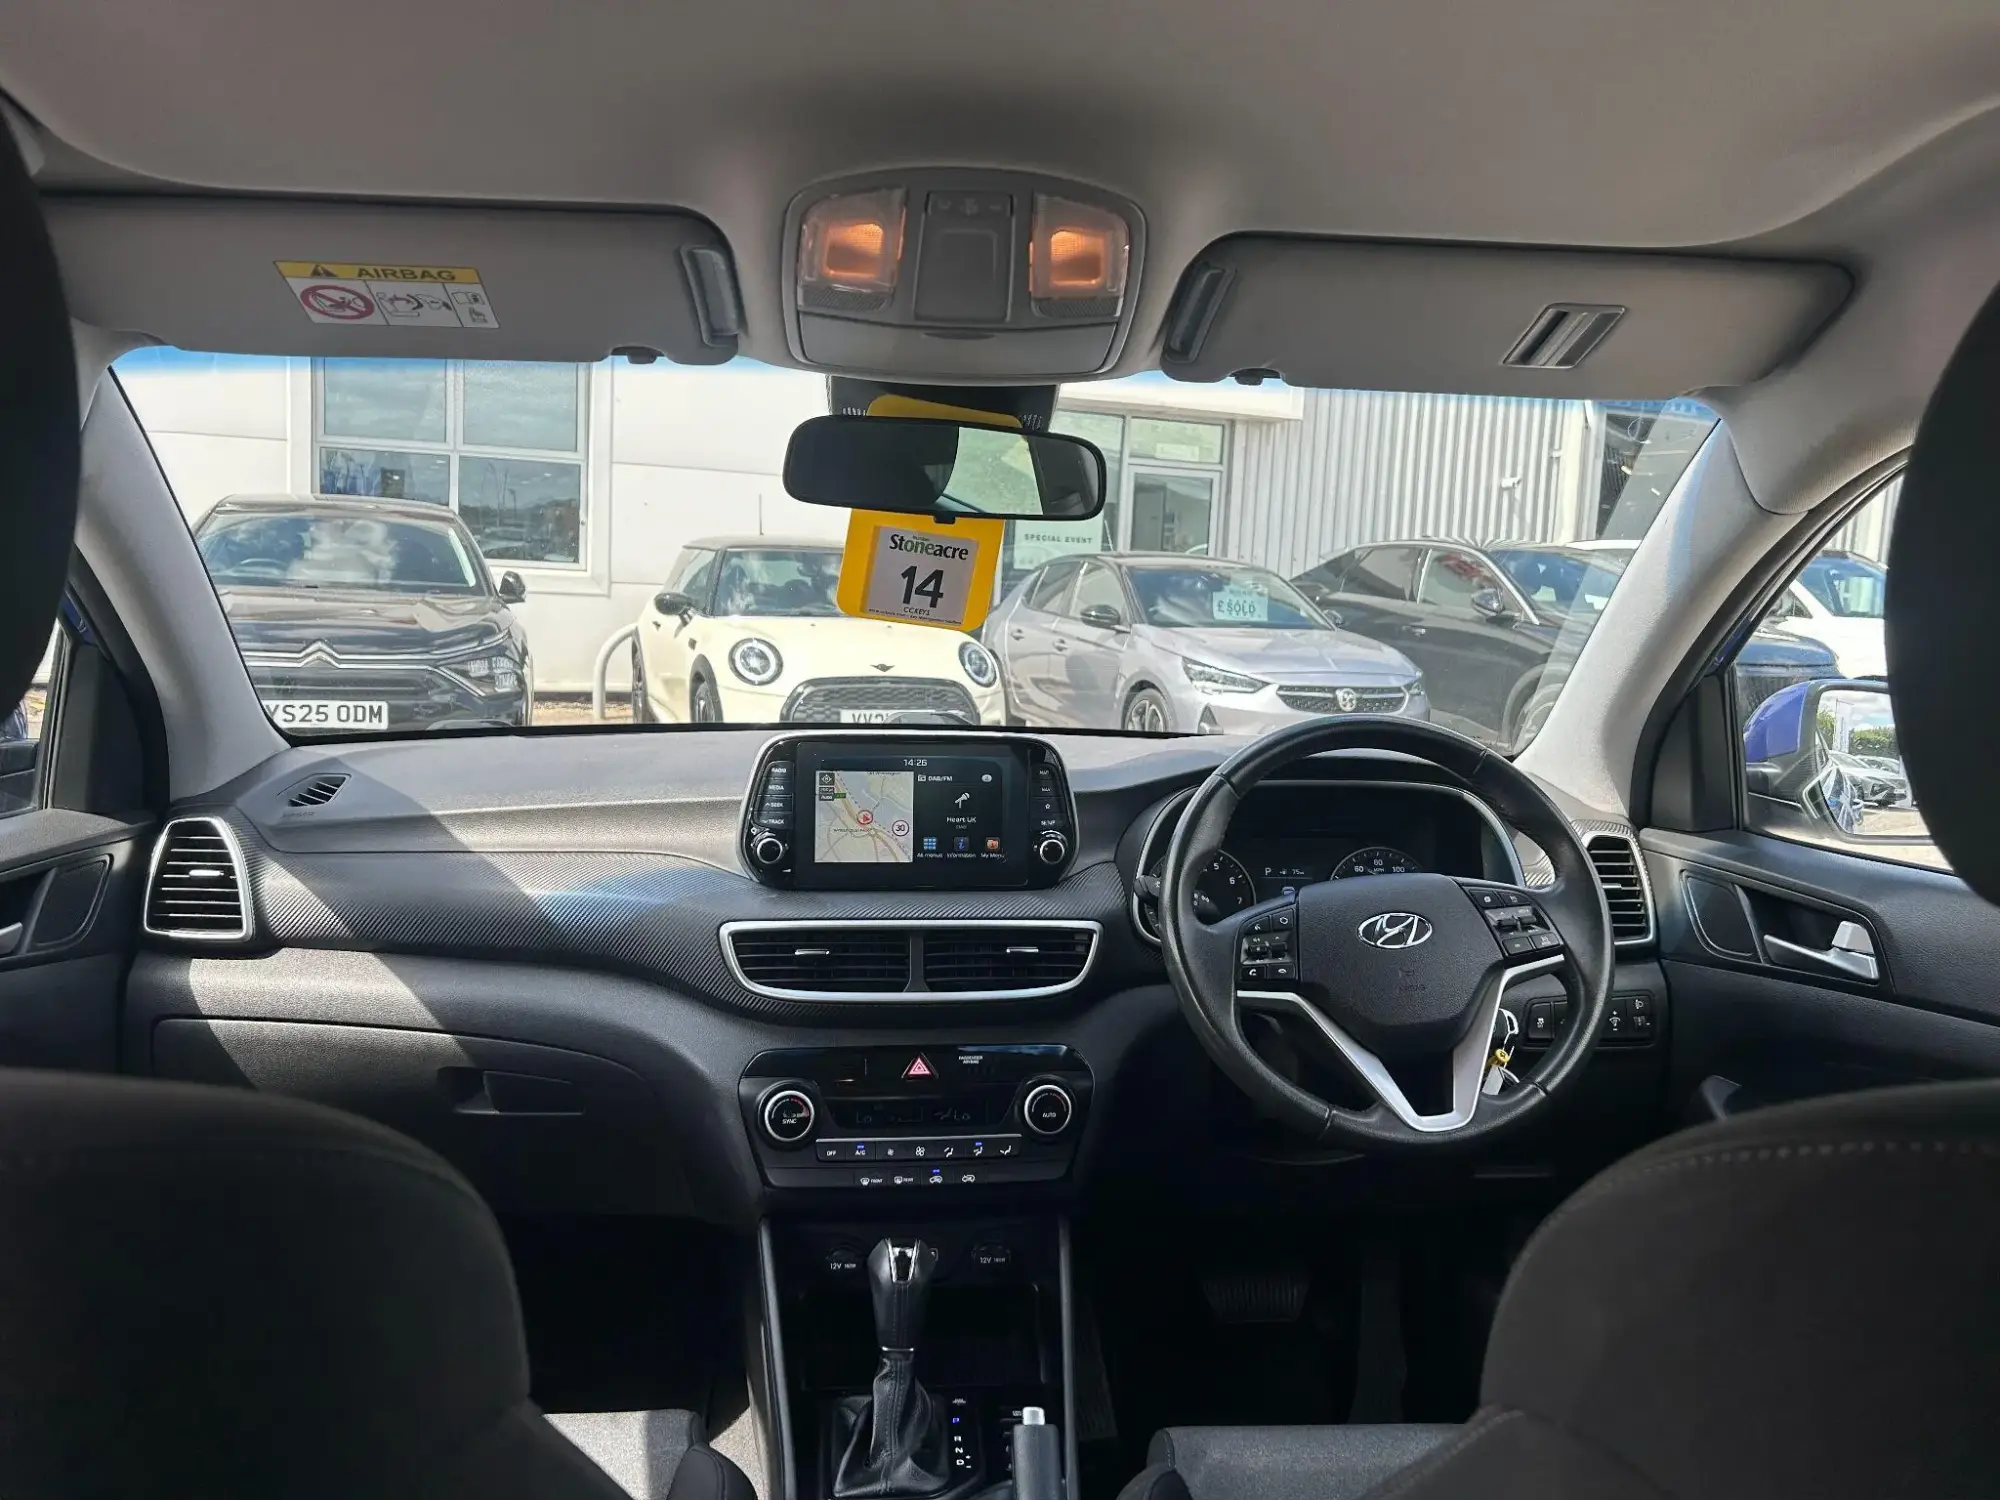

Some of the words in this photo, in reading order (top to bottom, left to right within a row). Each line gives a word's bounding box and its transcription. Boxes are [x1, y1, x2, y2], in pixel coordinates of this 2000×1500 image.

[358, 267, 456, 281] AIRBAG
[1024, 533, 1061, 543] SPECIAL
[1064, 536, 1093, 544] EVENT
[889, 533, 969, 561] Stoneacre
[901, 565, 944, 609] 14
[265, 703, 329, 724] YS25
[336, 704, 383, 724] ODM
[903, 758, 928, 767] 14:26
[895, 823, 906, 832] 30
[1373, 858, 1383, 866] 80
[1265, 867, 1272, 876] P
[1354, 865, 1364, 873] 60
[1229, 877, 1236, 885] 6
[826, 1149, 837, 1157] OFF
[980, 1256, 992, 1264] 12V
[830, 1262, 842, 1270] 12V
